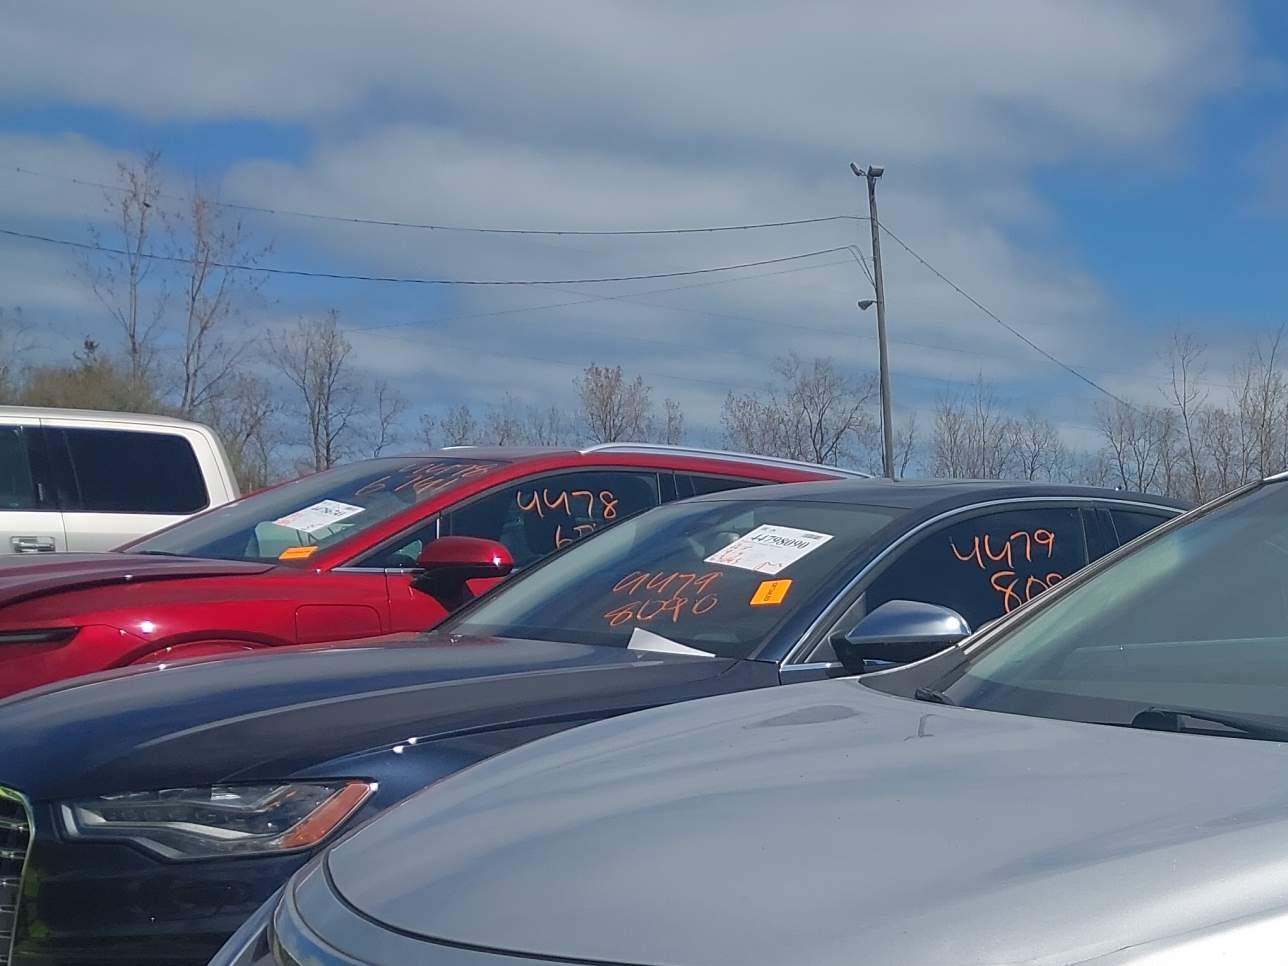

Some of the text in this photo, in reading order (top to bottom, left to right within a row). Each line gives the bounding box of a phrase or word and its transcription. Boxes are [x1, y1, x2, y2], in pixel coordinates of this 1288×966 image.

[516, 488, 619, 519] 4478
[949, 528, 1055, 570] 4479
[612, 571, 724, 598] 4479
